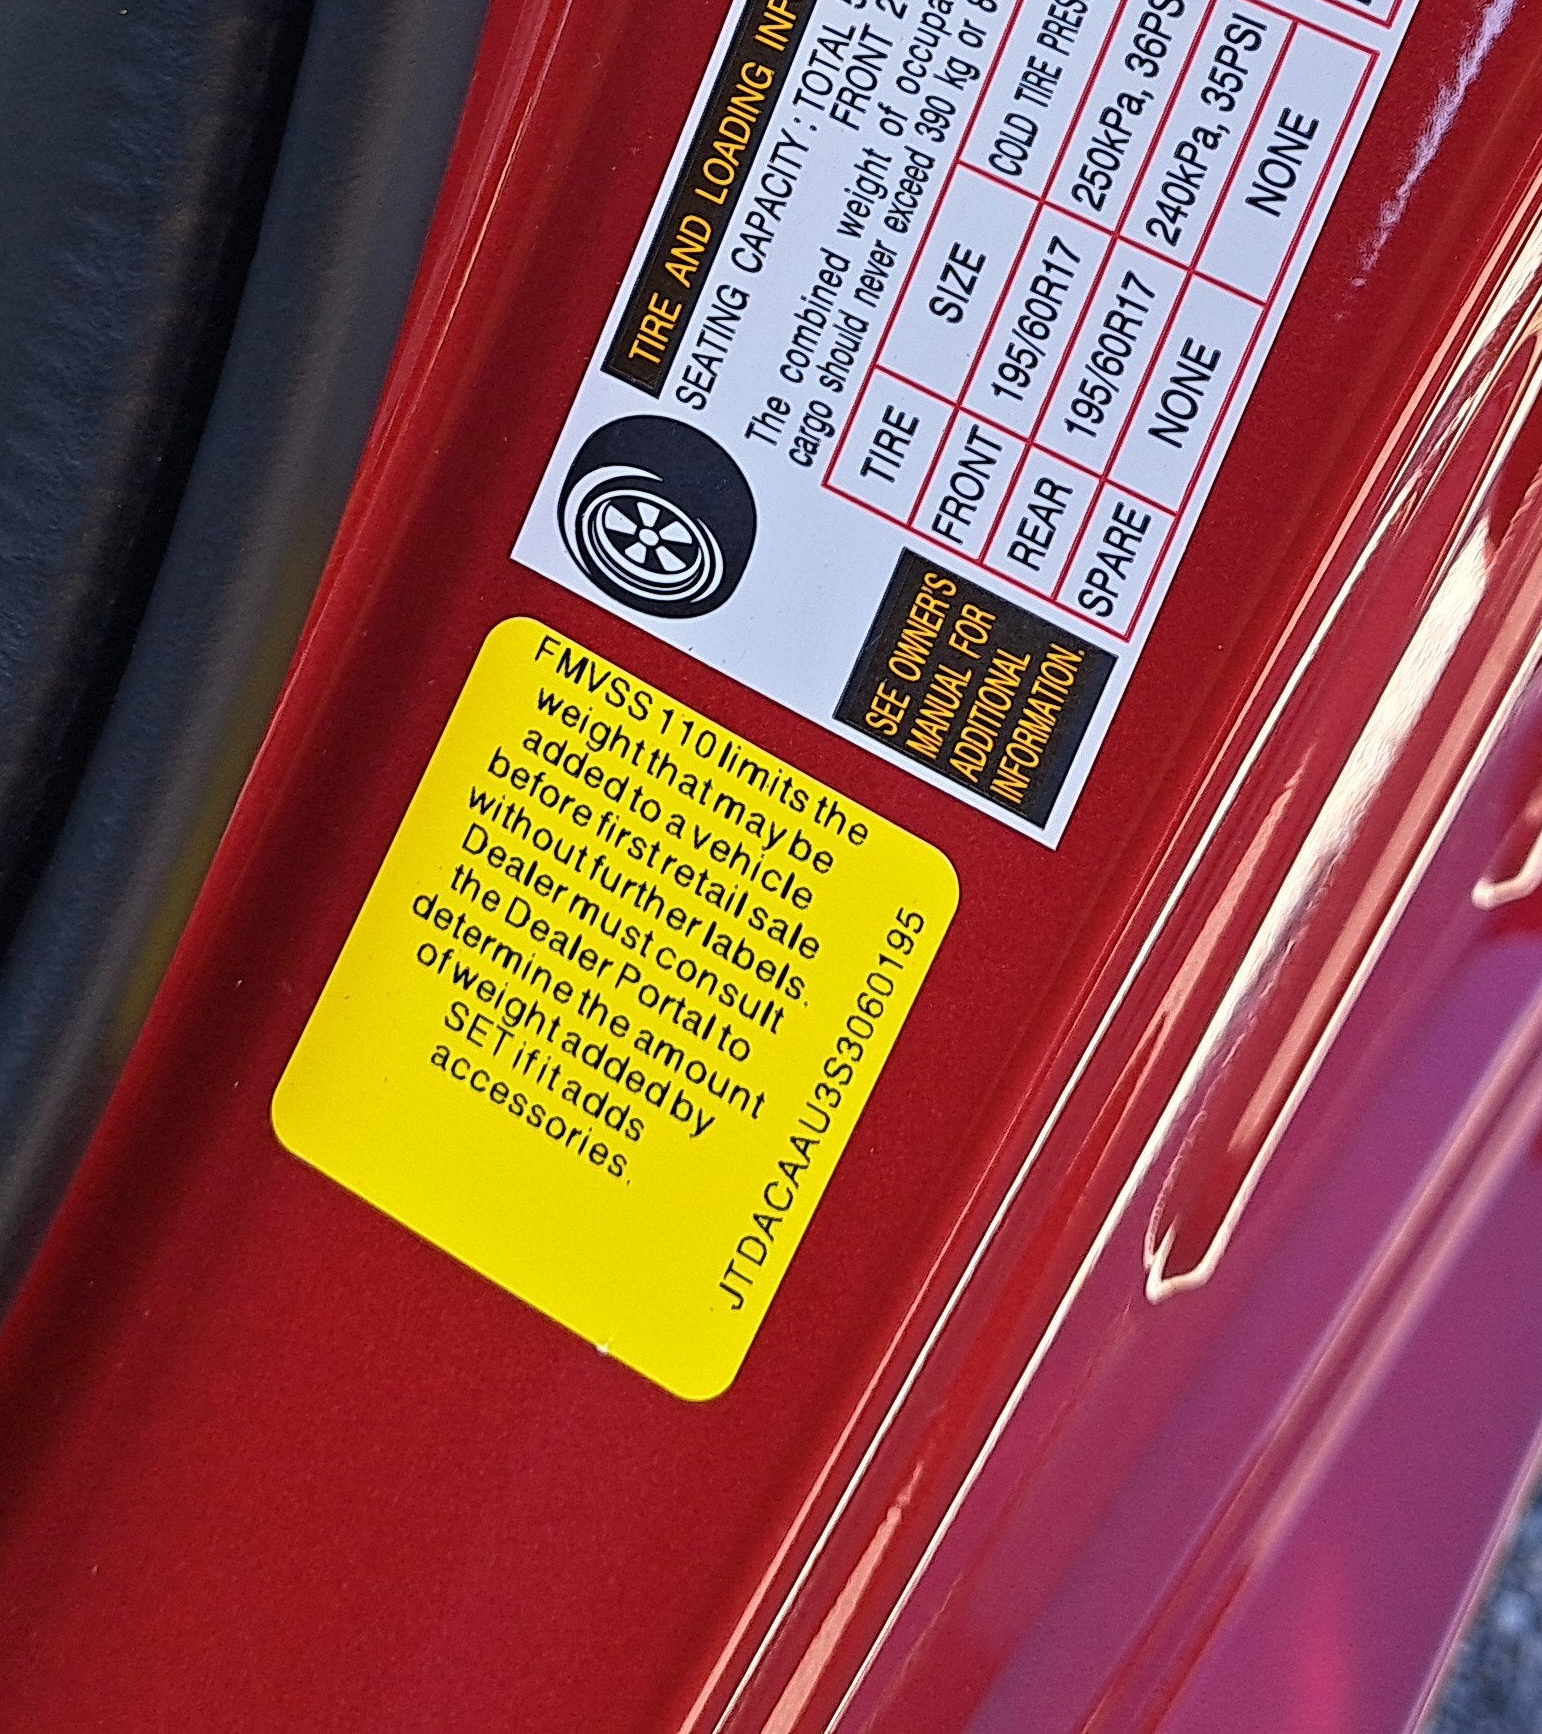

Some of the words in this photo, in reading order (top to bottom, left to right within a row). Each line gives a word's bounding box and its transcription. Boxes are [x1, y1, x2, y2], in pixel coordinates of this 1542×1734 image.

[828, 22, 893, 132] FRONT
[933, 55, 981, 91] kg
[957, 18, 987, 49] or
[1013, 55, 1063, 108] TIRE
[914, 95, 956, 143] 390
[988, 112, 1039, 177] COLD
[1070, 89, 1155, 212] 250kPa,
[1145, 123, 1231, 247] 240kPa,
[1200, 12, 1268, 113] 35PSI
[1244, 107, 1320, 218] NONE
[628, 292, 682, 364] TIRE
[665, 215, 712, 288] AND
[694, 61, 774, 205] LOADING
[675, 284, 751, 411] SEATING
[792, 24, 857, 111] TOTAL
[883, 145, 936, 234] exceed
[744, 396, 791, 446] The
[779, 246, 851, 384] combined
[836, 147, 893, 239] weight
[877, 101, 909, 137] of
[853, 238, 898, 309] never
[928, 241, 987, 324] SIZE
[990, 235, 1081, 402] 195/60R17
[815, 308, 870, 393] should
[1064, 269, 1156, 438] 195/60R17
[1147, 336, 1222, 449] NONE
[788, 399, 836, 468] cargo
[859, 404, 920, 483] TIRE
[931, 423, 1003, 546] FRONT
[1006, 477, 1074, 572] REAR
[1077, 501, 1152, 618] SPARE
[865, 683, 911, 736] SEE
[888, 572, 957, 682] OWNER'S
[905, 665, 972, 759] MANUAL
[948, 603, 996, 659] FOR
[949, 649, 1031, 783] ADDITIONAL
[990, 644, 1084, 804] INFORMATION.
[534, 634, 653, 721] FMVSS
[660, 708, 717, 759] 110
[717, 740, 809, 813] limits
[814, 796, 869, 846] the
[537, 687, 646, 767] weight
[646, 748, 713, 806] that
[712, 792, 788, 852] may
[787, 829, 834, 874] be
[487, 746, 593, 828] before
[596, 811, 661, 869] first
[660, 854, 749, 919] retail
[747, 906, 820, 960] sale
[522, 729, 630, 803] added
[629, 785, 662, 823] to
[693, 824, 813, 910] vehicle
[450, 863, 501, 913] the
[504, 896, 614, 978] Dealer
[614, 962, 717, 1041] Portal
[717, 1024, 751, 1062] to
[461, 822, 569, 904] Dealer
[568, 893, 654, 958] must
[655, 946, 785, 1035] consult
[469, 786, 588, 873] without
[589, 854, 703, 938] further
[701, 920, 808, 1007] labels.
[412, 893, 574, 1005] determine
[577, 988, 630, 1038] the
[633, 1029, 765, 1120] amount
[416, 942, 455, 975] of
[452, 961, 561, 1043] weight
[561, 1031, 671, 1108] added
[669, 1088, 716, 1138] by
[444, 1001, 515, 1057] SET
[561, 1080, 645, 1142] adds
[430, 1045, 630, 1185] accessories.
[719, 907, 925, 1310] JTDACAAU3S3060195
